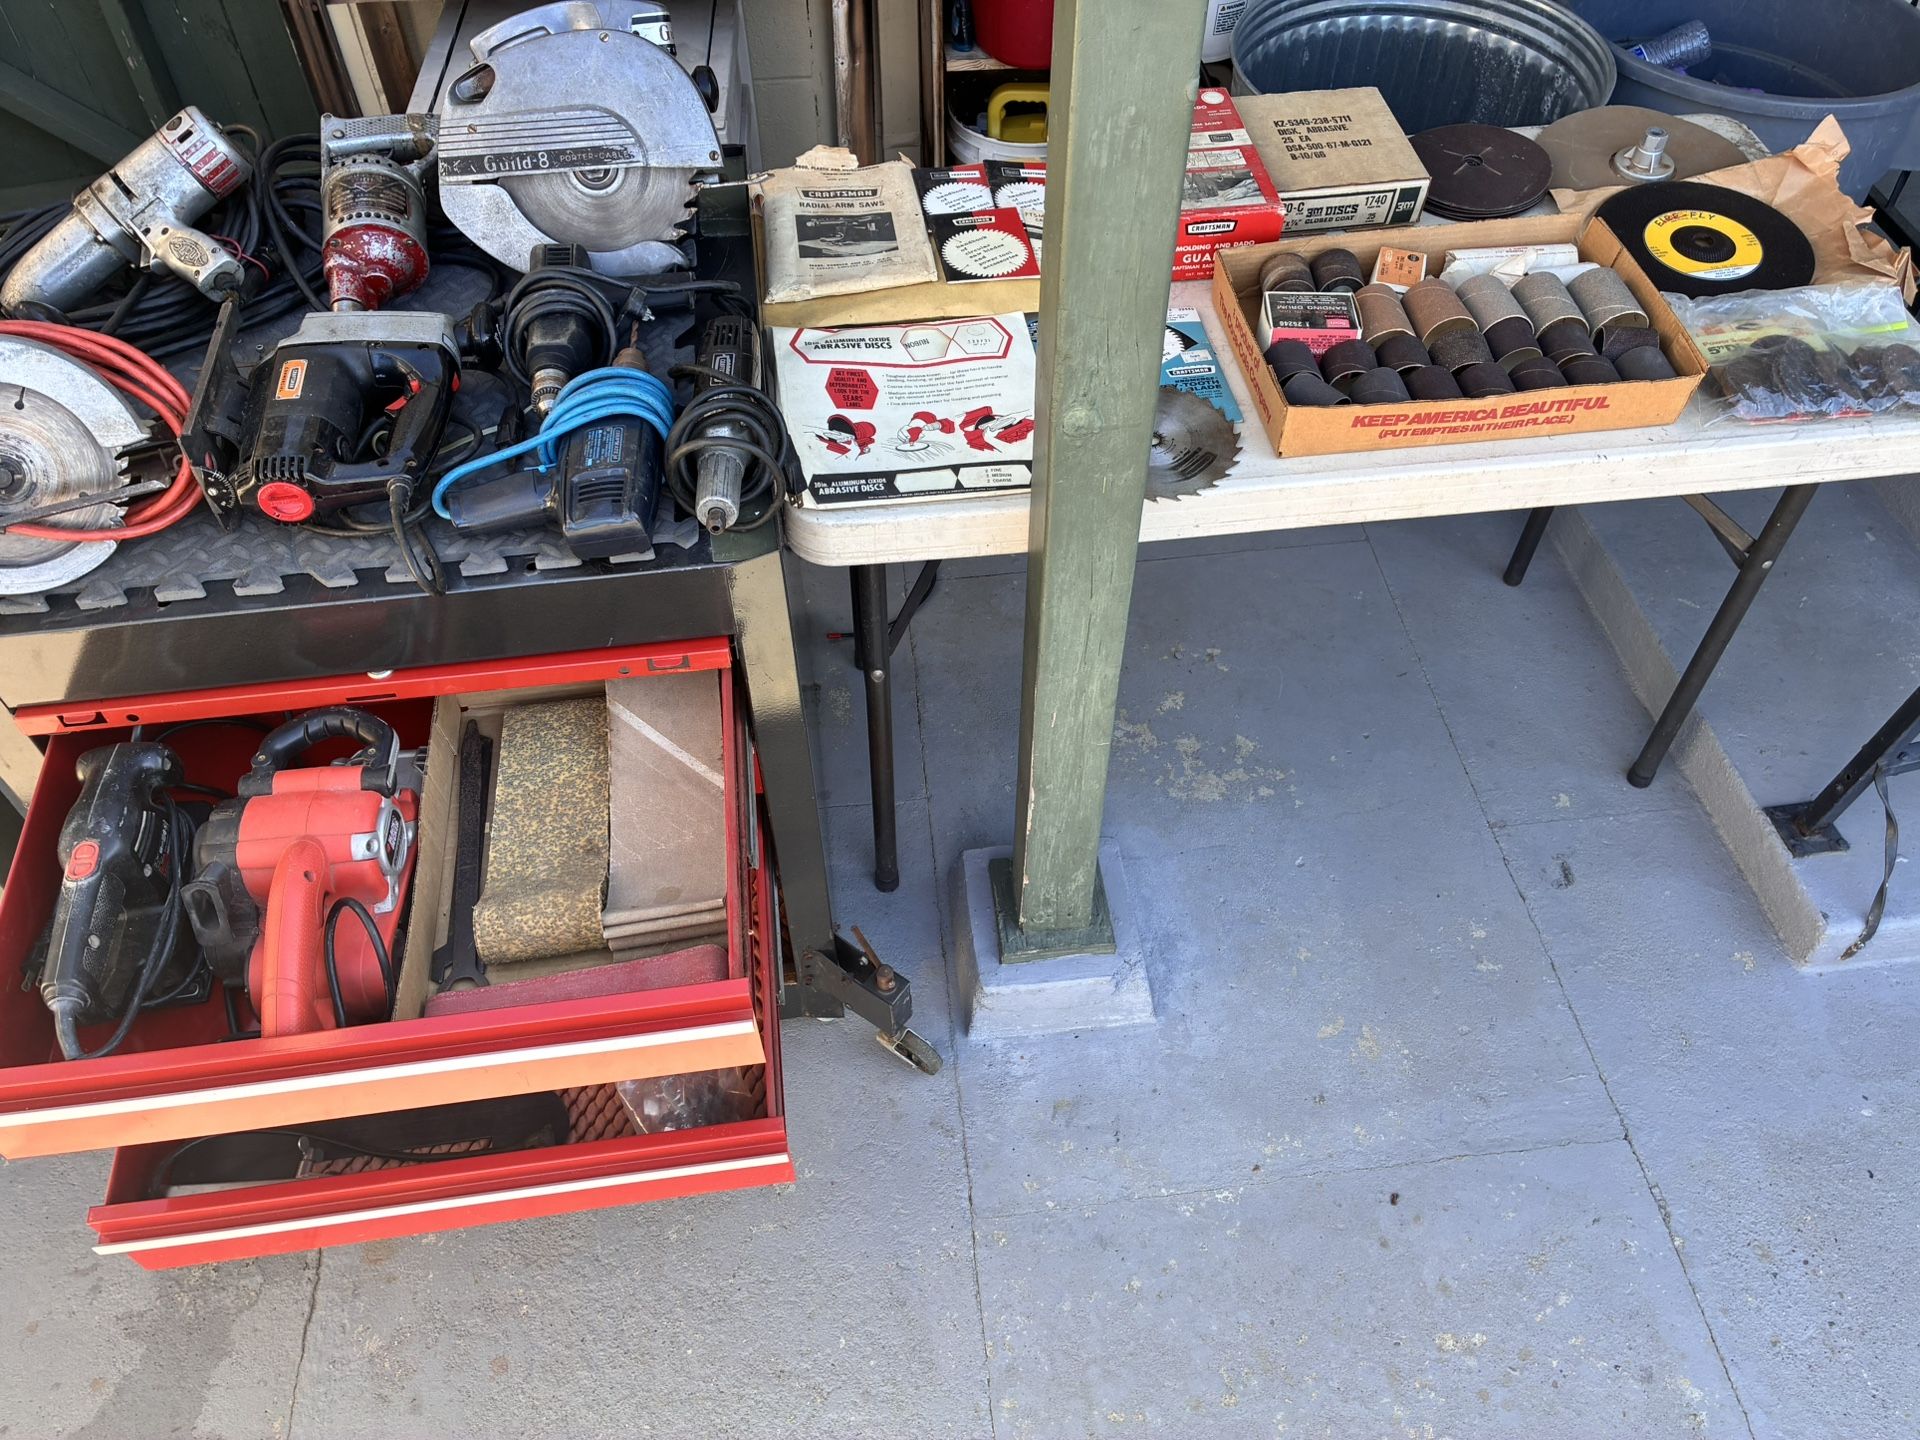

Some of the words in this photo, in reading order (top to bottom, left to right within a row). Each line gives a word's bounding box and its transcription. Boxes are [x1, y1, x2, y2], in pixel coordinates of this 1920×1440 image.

[1273, 115, 1352, 128] KZ-5345-238-5711
[1306, 124, 1349, 134] ABRASIVE
[1281, 136, 1294, 144] 25
[1298, 135, 1312, 143] EA
[484, 152, 550, 172] Guild-8
[808, 190, 872, 198] CRAFTSMAN
[799, 201, 855, 209] RADIAL-ARM
[859, 200, 885, 208] SAWS
[1365, 194, 1388, 207] 1740
[1325, 204, 1359, 216] DISCS
[1191, 223, 1231, 232] CRAFTSMAN
[1175, 243, 1211, 252] MOLDING
[1214, 241, 1231, 249] AND
[1233, 240, 1255, 248] DADO
[1183, 252, 1216, 264] GUA
[813, 342, 862, 350] ABRASIVE
[865, 341, 893, 350] DISCS
[1172, 367, 1209, 375] CRAFTSMAN
[1351, 415, 1409, 428] KEEP
[1407, 408, 1499, 426] AMERICA
[1500, 396, 1610, 419] BEAUTIFUL
[1378, 428, 1414, 440] (PUT
[1410, 424, 1471, 437] EMPTIES
[1468, 423, 1487, 433] IN
[1484, 419, 1527, 432] THEIR
[831, 479, 866, 488] ALUMINUM
[818, 485, 860, 496] ABRASIVE
[861, 484, 885, 493] DISCS
